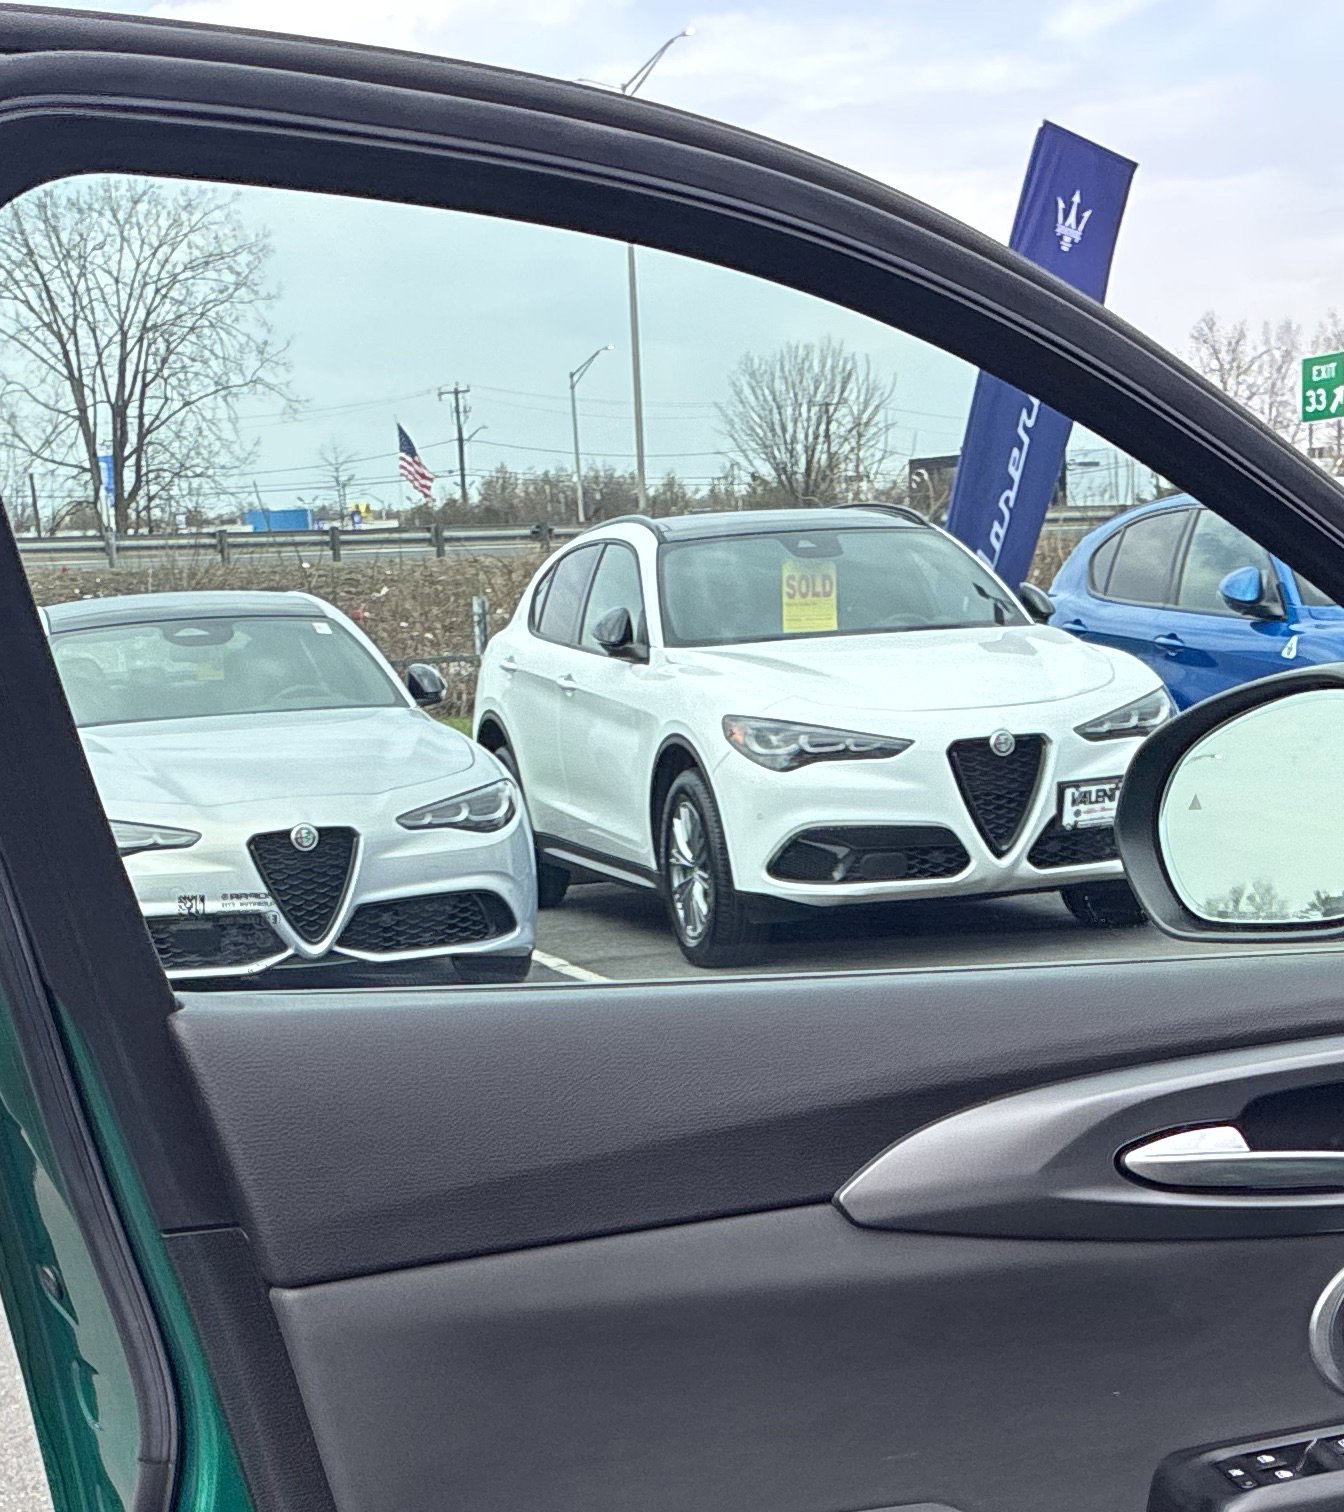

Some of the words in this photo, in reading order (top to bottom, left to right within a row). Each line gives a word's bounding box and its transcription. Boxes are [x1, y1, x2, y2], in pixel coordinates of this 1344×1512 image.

[1312, 362, 1337, 381] EXIT
[1305, 388, 1327, 412] 33
[785, 574, 833, 599] SOLD
